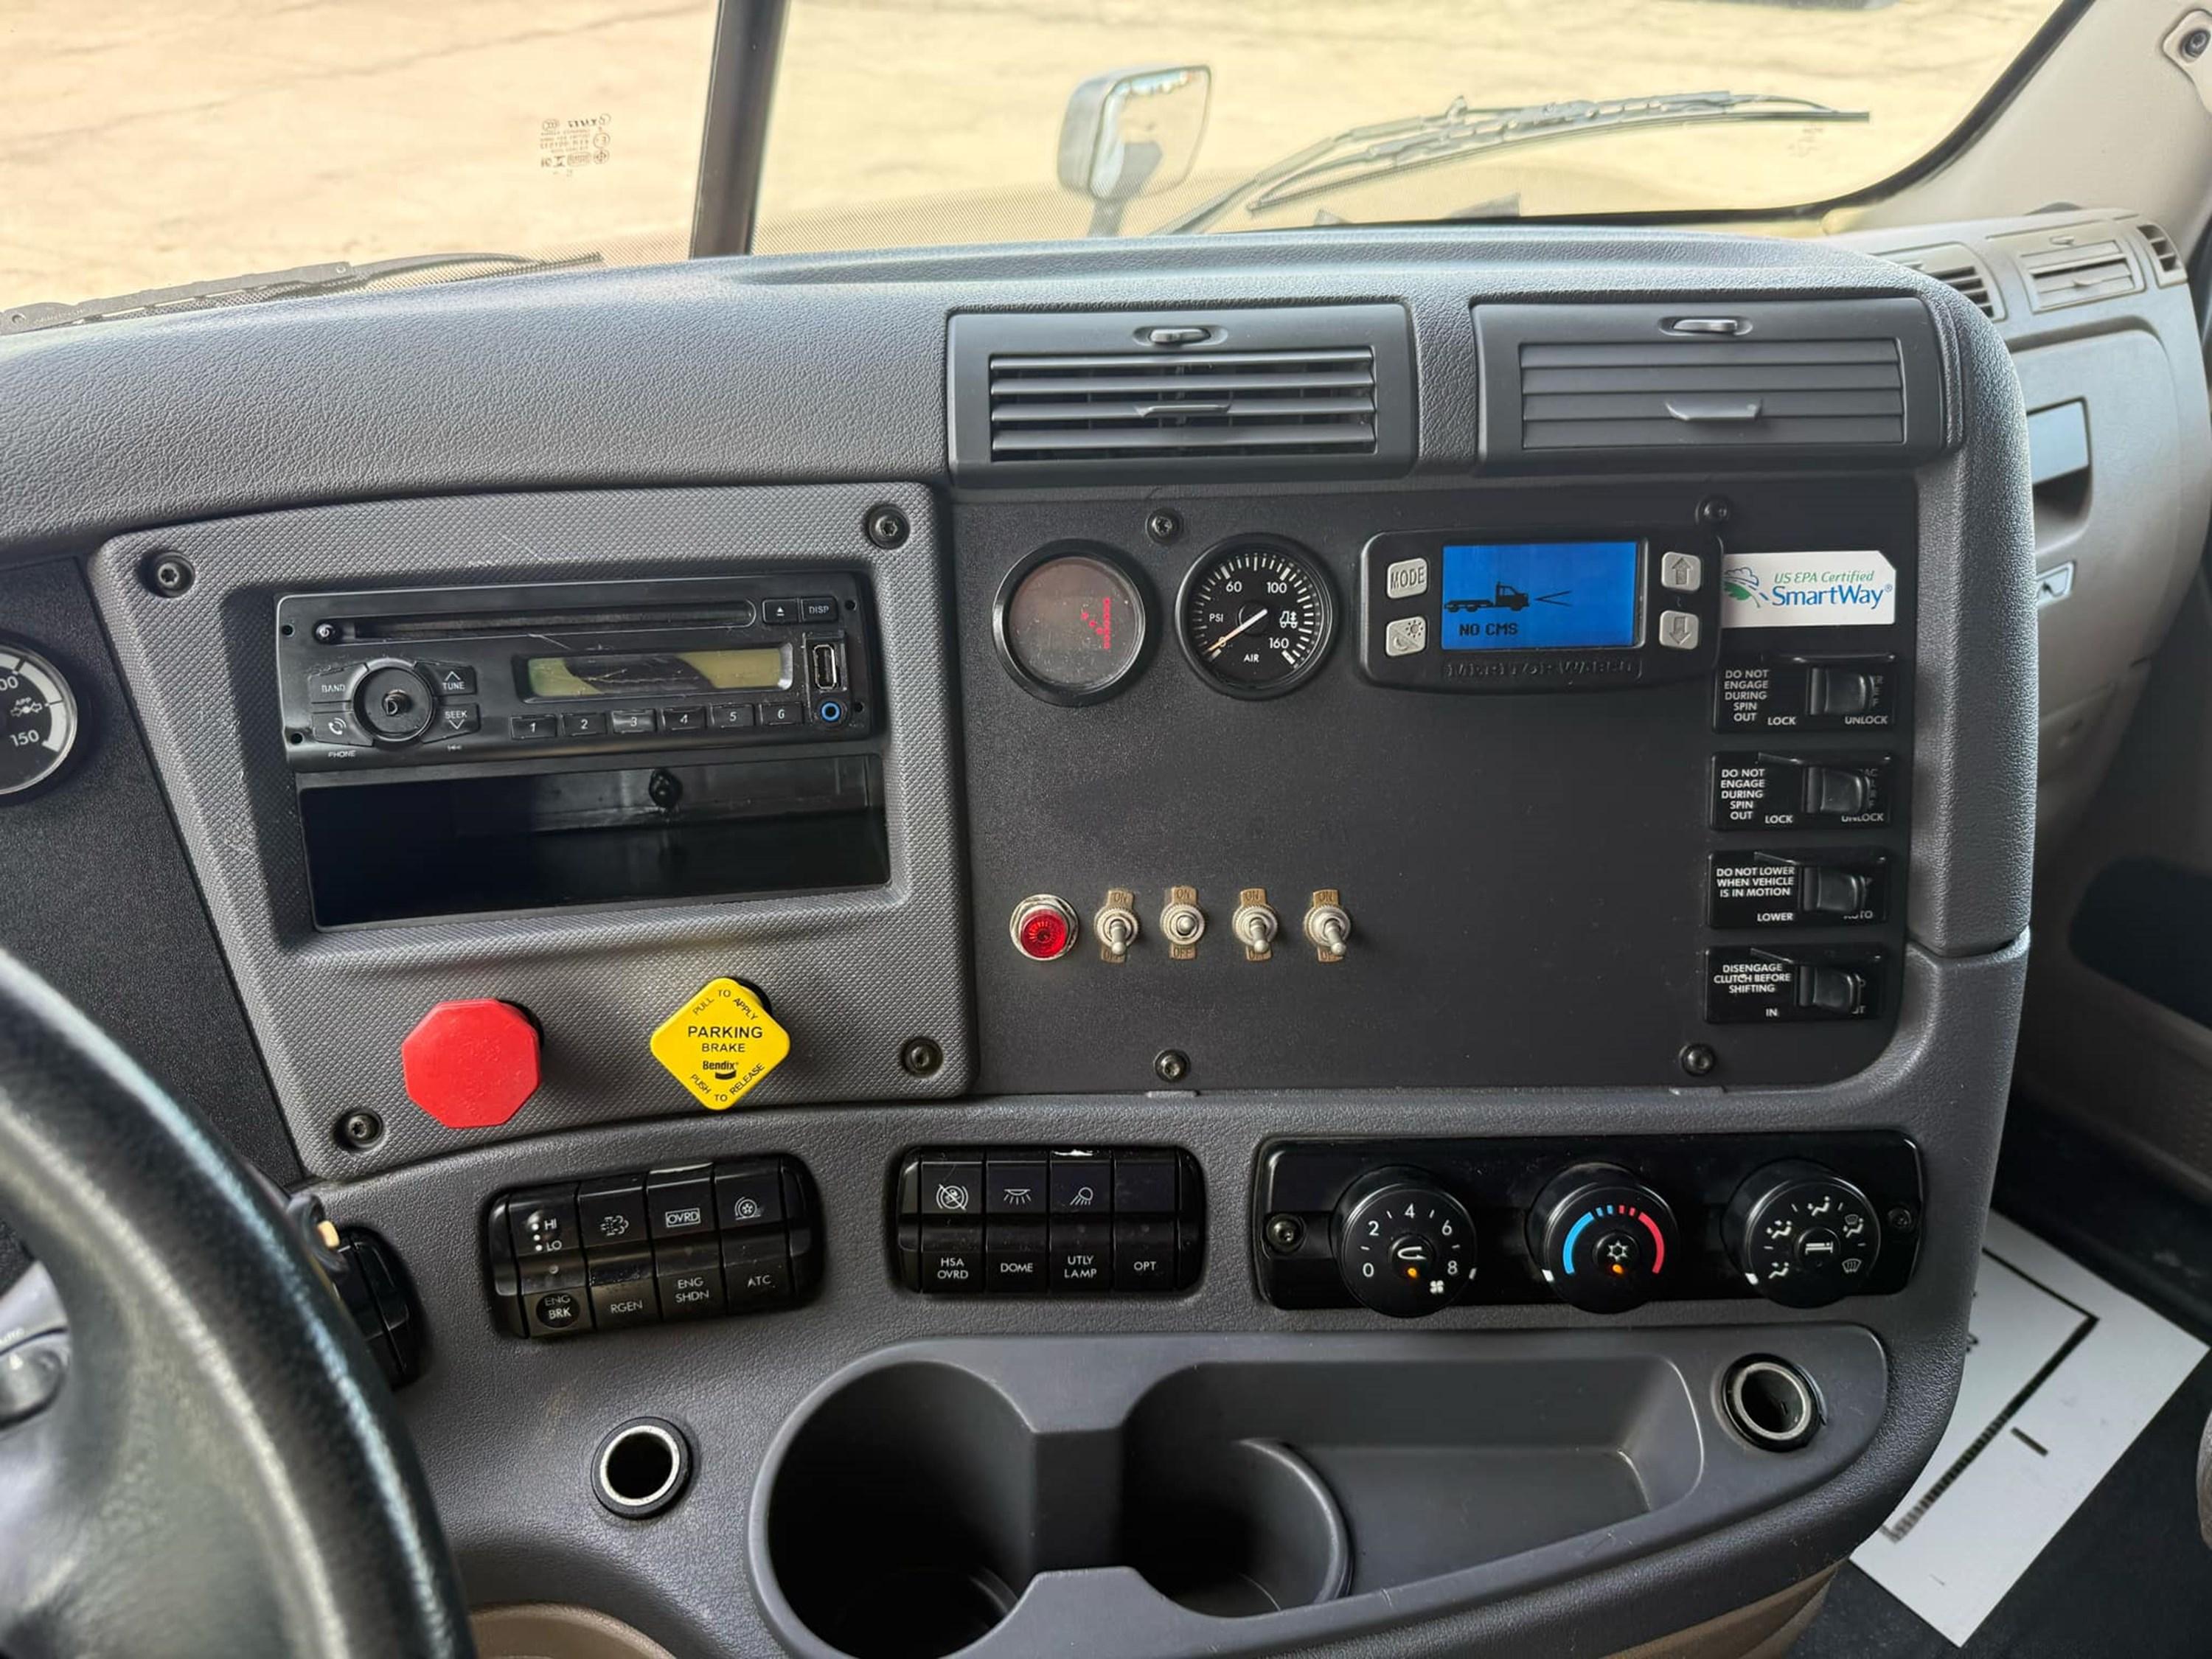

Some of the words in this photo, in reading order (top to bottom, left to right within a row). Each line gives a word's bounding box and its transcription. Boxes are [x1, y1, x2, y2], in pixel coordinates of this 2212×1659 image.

[1390, 566, 1425, 591] MODE
[1774, 572, 1792, 582] US
[1794, 572, 1818, 582] EPA
[1820, 570, 1875, 582] Certified
[1226, 582, 1242, 593] 60
[1267, 582, 1287, 594] 100
[808, 605, 830, 614] DISP
[1209, 613, 1224, 623] PSI
[1459, 624, 1480, 636] NO
[1485, 622, 1519, 636] CMS
[1268, 637, 1290, 650] 160
[1244, 653, 1259, 663] AIR
[1725, 670, 1742, 679] DO
[1745, 669, 1769, 678] NOT
[321, 684, 346, 693] BAND
[442, 681, 466, 690] TUNE
[1724, 681, 1769, 689] ENGAGE
[1725, 692, 1767, 700] DURING
[1733, 703, 1758, 712] SPIN
[445, 710, 468, 720] SEEK
[680, 714, 688, 725] 4
[729, 712, 737, 722] 5
[778, 709, 785, 720] 6
[1733, 712, 1757, 722] OUT
[580, 719, 588, 729] 2
[630, 717, 638, 727] 3
[1767, 717, 1797, 726] LOCK
[1845, 715, 1888, 725] UNLOCK
[529, 722, 536, 732] 1
[10, 729, 39, 747] 150
[327, 750, 356, 759] PHONE
[1722, 769, 1739, 778] DO
[1741, 768, 1766, 777] NOT
[1721, 779, 1766, 788] ENGAGE
[1721, 790, 1764, 799] DURING
[1730, 801, 1753, 810] SPIN
[1730, 811, 1753, 820] OUT
[1764, 815, 1794, 824] LOCK
[1717, 868, 1733, 877] DO
[1734, 867, 1759, 877] NOT
[1759, 866, 1795, 876] LOWER
[1717, 877, 1750, 887] WHEN
[1753, 877, 1794, 886] VEHICLE
[1113, 892, 1127, 903] ON
[1176, 889, 1190, 900] ON
[1245, 891, 1259, 900] ON
[1720, 888, 1729, 898] IS
[1732, 888, 1745, 897] IN
[1746, 888, 1791, 897] MOTION
[1757, 912, 1794, 922] LOWER
[1173, 947, 1192, 957] OFF
[1722, 964, 1783, 973] DISENGAGE
[1714, 974, 1753, 984] CLUTCH
[1754, 973, 1792, 983] BEFORE
[1728, 984, 1776, 994] SHIFTING
[692, 998, 714, 1015] PULL
[733, 998, 759, 1021] APPLY
[1765, 1008, 1779, 1017] IN
[687, 1026, 764, 1039] PARKING
[701, 1043, 745, 1053] BRAKE
[702, 1060, 736, 1071] Bendix
[691, 1074, 711, 1094] PUSH
[729, 1062, 765, 1095] RELEASE
[1405, 1204, 1415, 1219] 4
[667, 1211, 699, 1225] OVRD
[543, 1218, 558, 1230] HI
[1368, 1221, 1380, 1237] 2
[1441, 1220, 1453, 1235] 6
[546, 1239, 563, 1252] LO
[941, 1257, 964, 1267] HSA
[1067, 1256, 1094, 1266] UTLY
[1133, 1261, 1157, 1271] OPT
[1001, 1262, 1033, 1273] DOME
[1363, 1263, 1374, 1278] 0
[1447, 1261, 1458, 1275] 8
[937, 1270, 969, 1280] OVRD
[1064, 1268, 1097, 1279] LAMP
[677, 1276, 704, 1289] ENG
[747, 1275, 772, 1288] ATC
[543, 1294, 571, 1307] ENG
[675, 1290, 709, 1304] SHDN
[610, 1301, 643, 1314] RGEN
[549, 1307, 571, 1320] BRK
